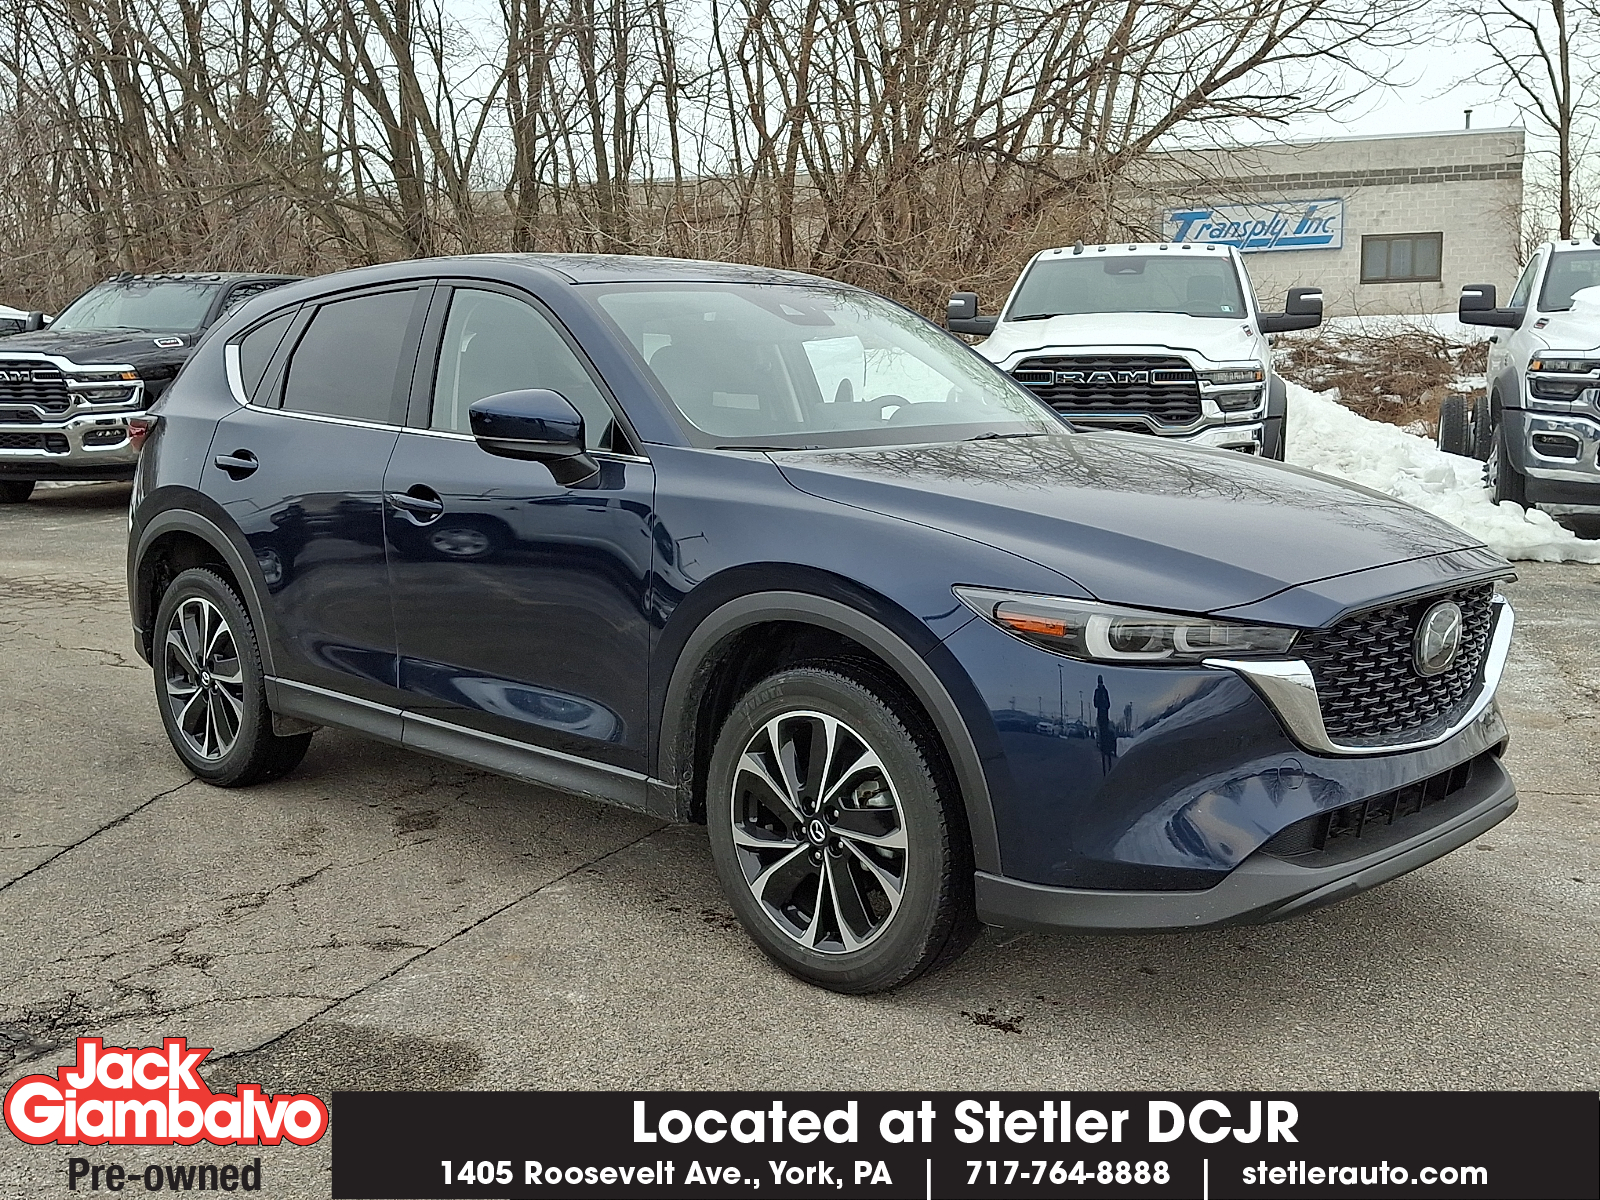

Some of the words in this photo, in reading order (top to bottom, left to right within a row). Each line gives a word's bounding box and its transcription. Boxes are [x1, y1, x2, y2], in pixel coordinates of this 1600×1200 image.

[1294, 205, 1335, 235] Inc.
[0, 370, 30, 381] AM
[1055, 371, 1149, 384] RAM
